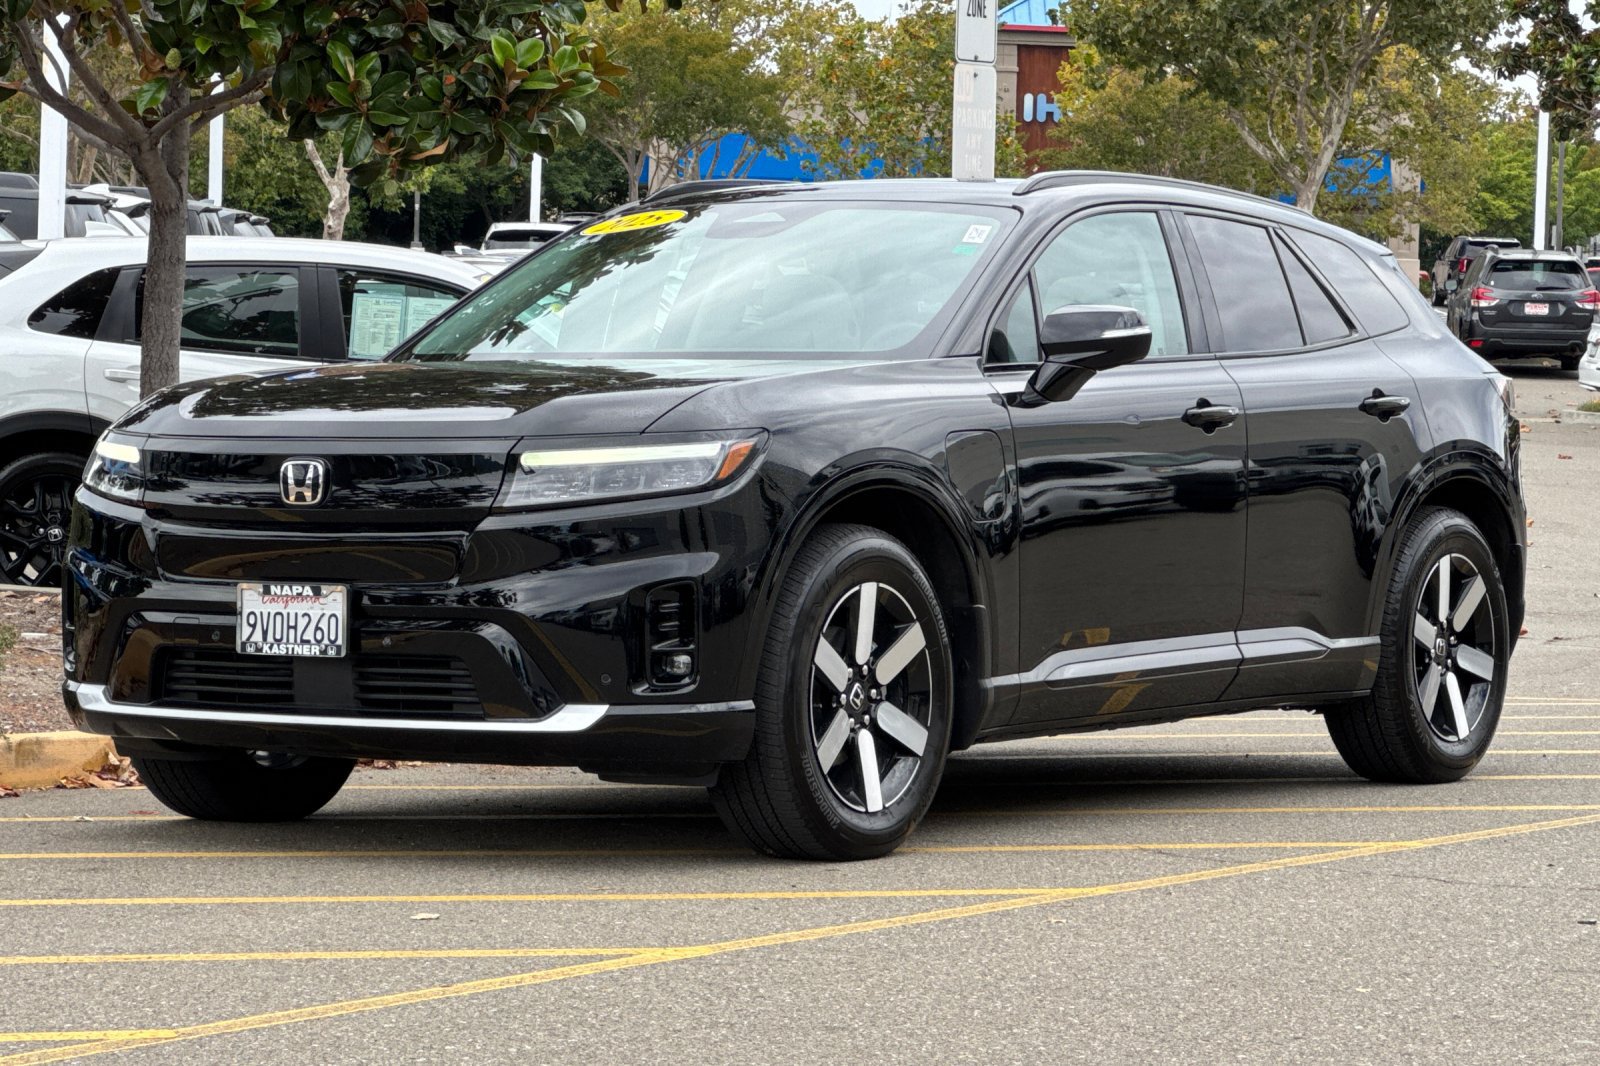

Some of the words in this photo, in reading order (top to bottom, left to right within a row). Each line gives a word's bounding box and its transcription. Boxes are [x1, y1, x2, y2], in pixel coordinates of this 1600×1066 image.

[967, 0, 987, 18] ZONE
[956, 107, 993, 129] PARKING
[965, 154, 983, 171] TIME
[270, 585, 313, 596] NAPA
[246, 610, 339, 645] 9VOH260
[262, 643, 320, 656] KASTNER
